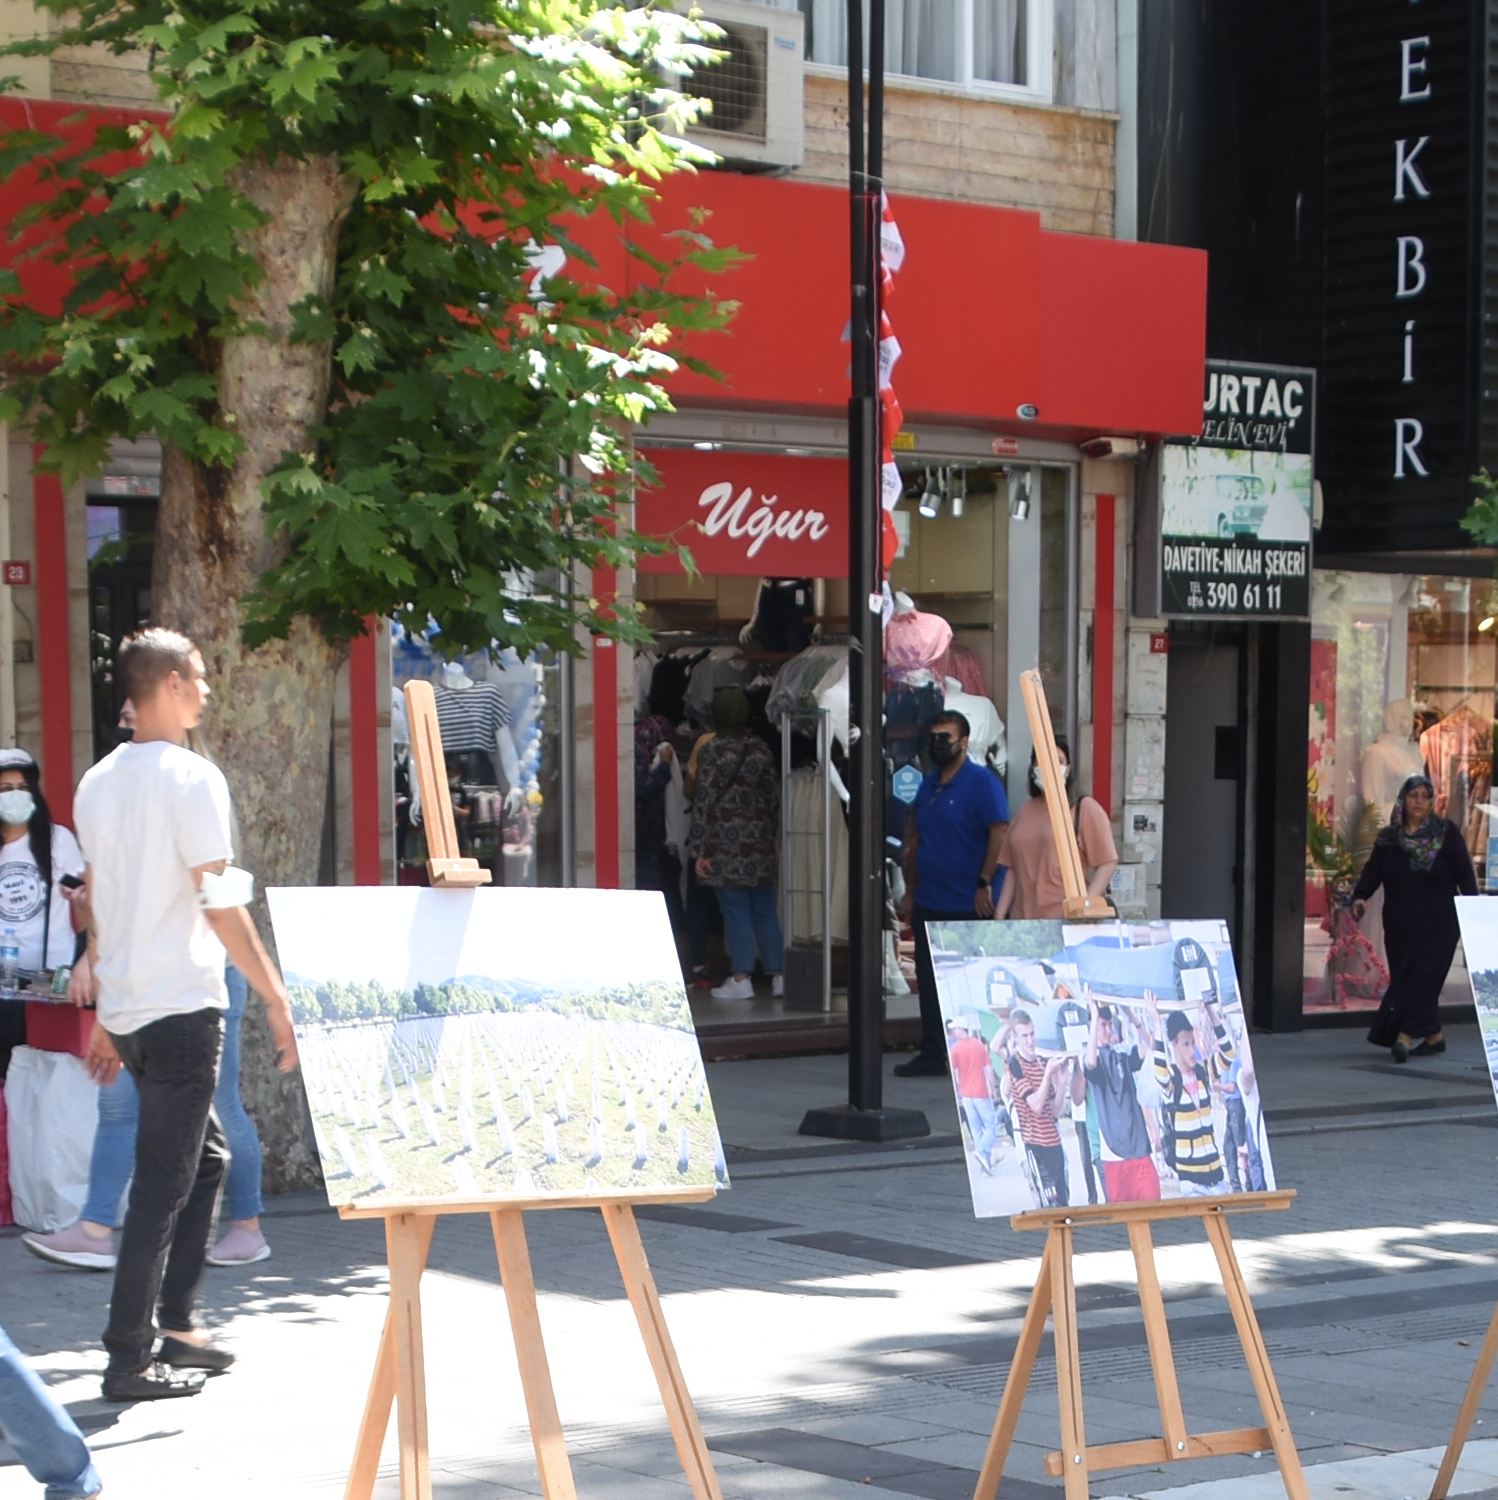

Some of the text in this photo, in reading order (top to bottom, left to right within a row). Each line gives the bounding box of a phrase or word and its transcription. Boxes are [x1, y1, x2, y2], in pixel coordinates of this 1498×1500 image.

[1394, 0, 1432, 478] EKBİR
[1204, 373, 1304, 427] URTAÇ
[1191, 415, 1288, 447] ELİN EVİ
[698, 482, 829, 559] Uğur
[8, 565, 24, 579] 23
[1164, 541, 1306, 580] DAVETİYE-NİKAH ŞEKERİ
[1207, 582, 1238, 607] 390
[1243, 583, 1260, 609] 61
[1266, 584, 1281, 609] 11
[1154, 638, 1165, 649] 27
